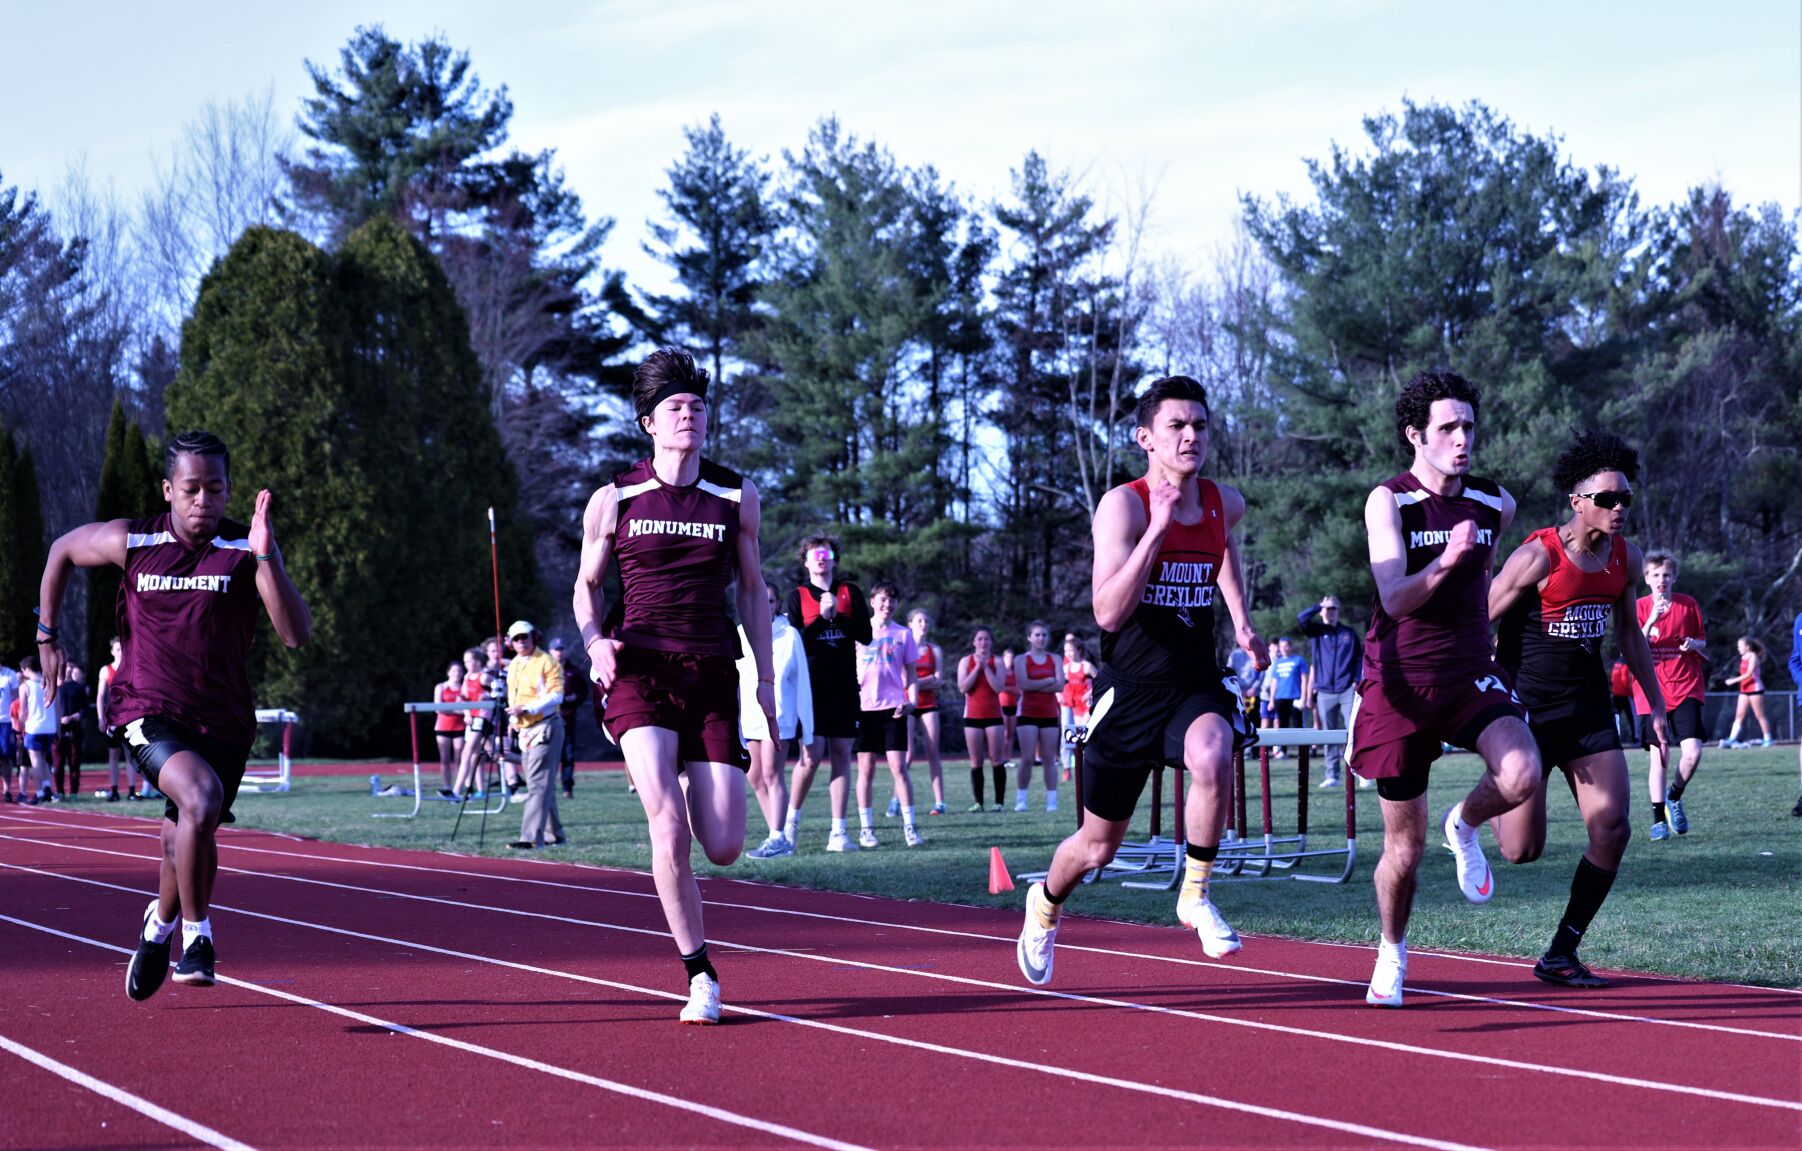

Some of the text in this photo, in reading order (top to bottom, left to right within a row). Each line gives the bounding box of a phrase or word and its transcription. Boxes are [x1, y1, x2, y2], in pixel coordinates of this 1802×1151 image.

[628, 519, 726, 542] MONUMENT
[1410, 529, 1492, 549] MONUNT
[1159, 561, 1213, 583] MOUNT
[137, 573, 231, 593] MONUMENT
[1548, 619, 1608, 638] GREYLOC
